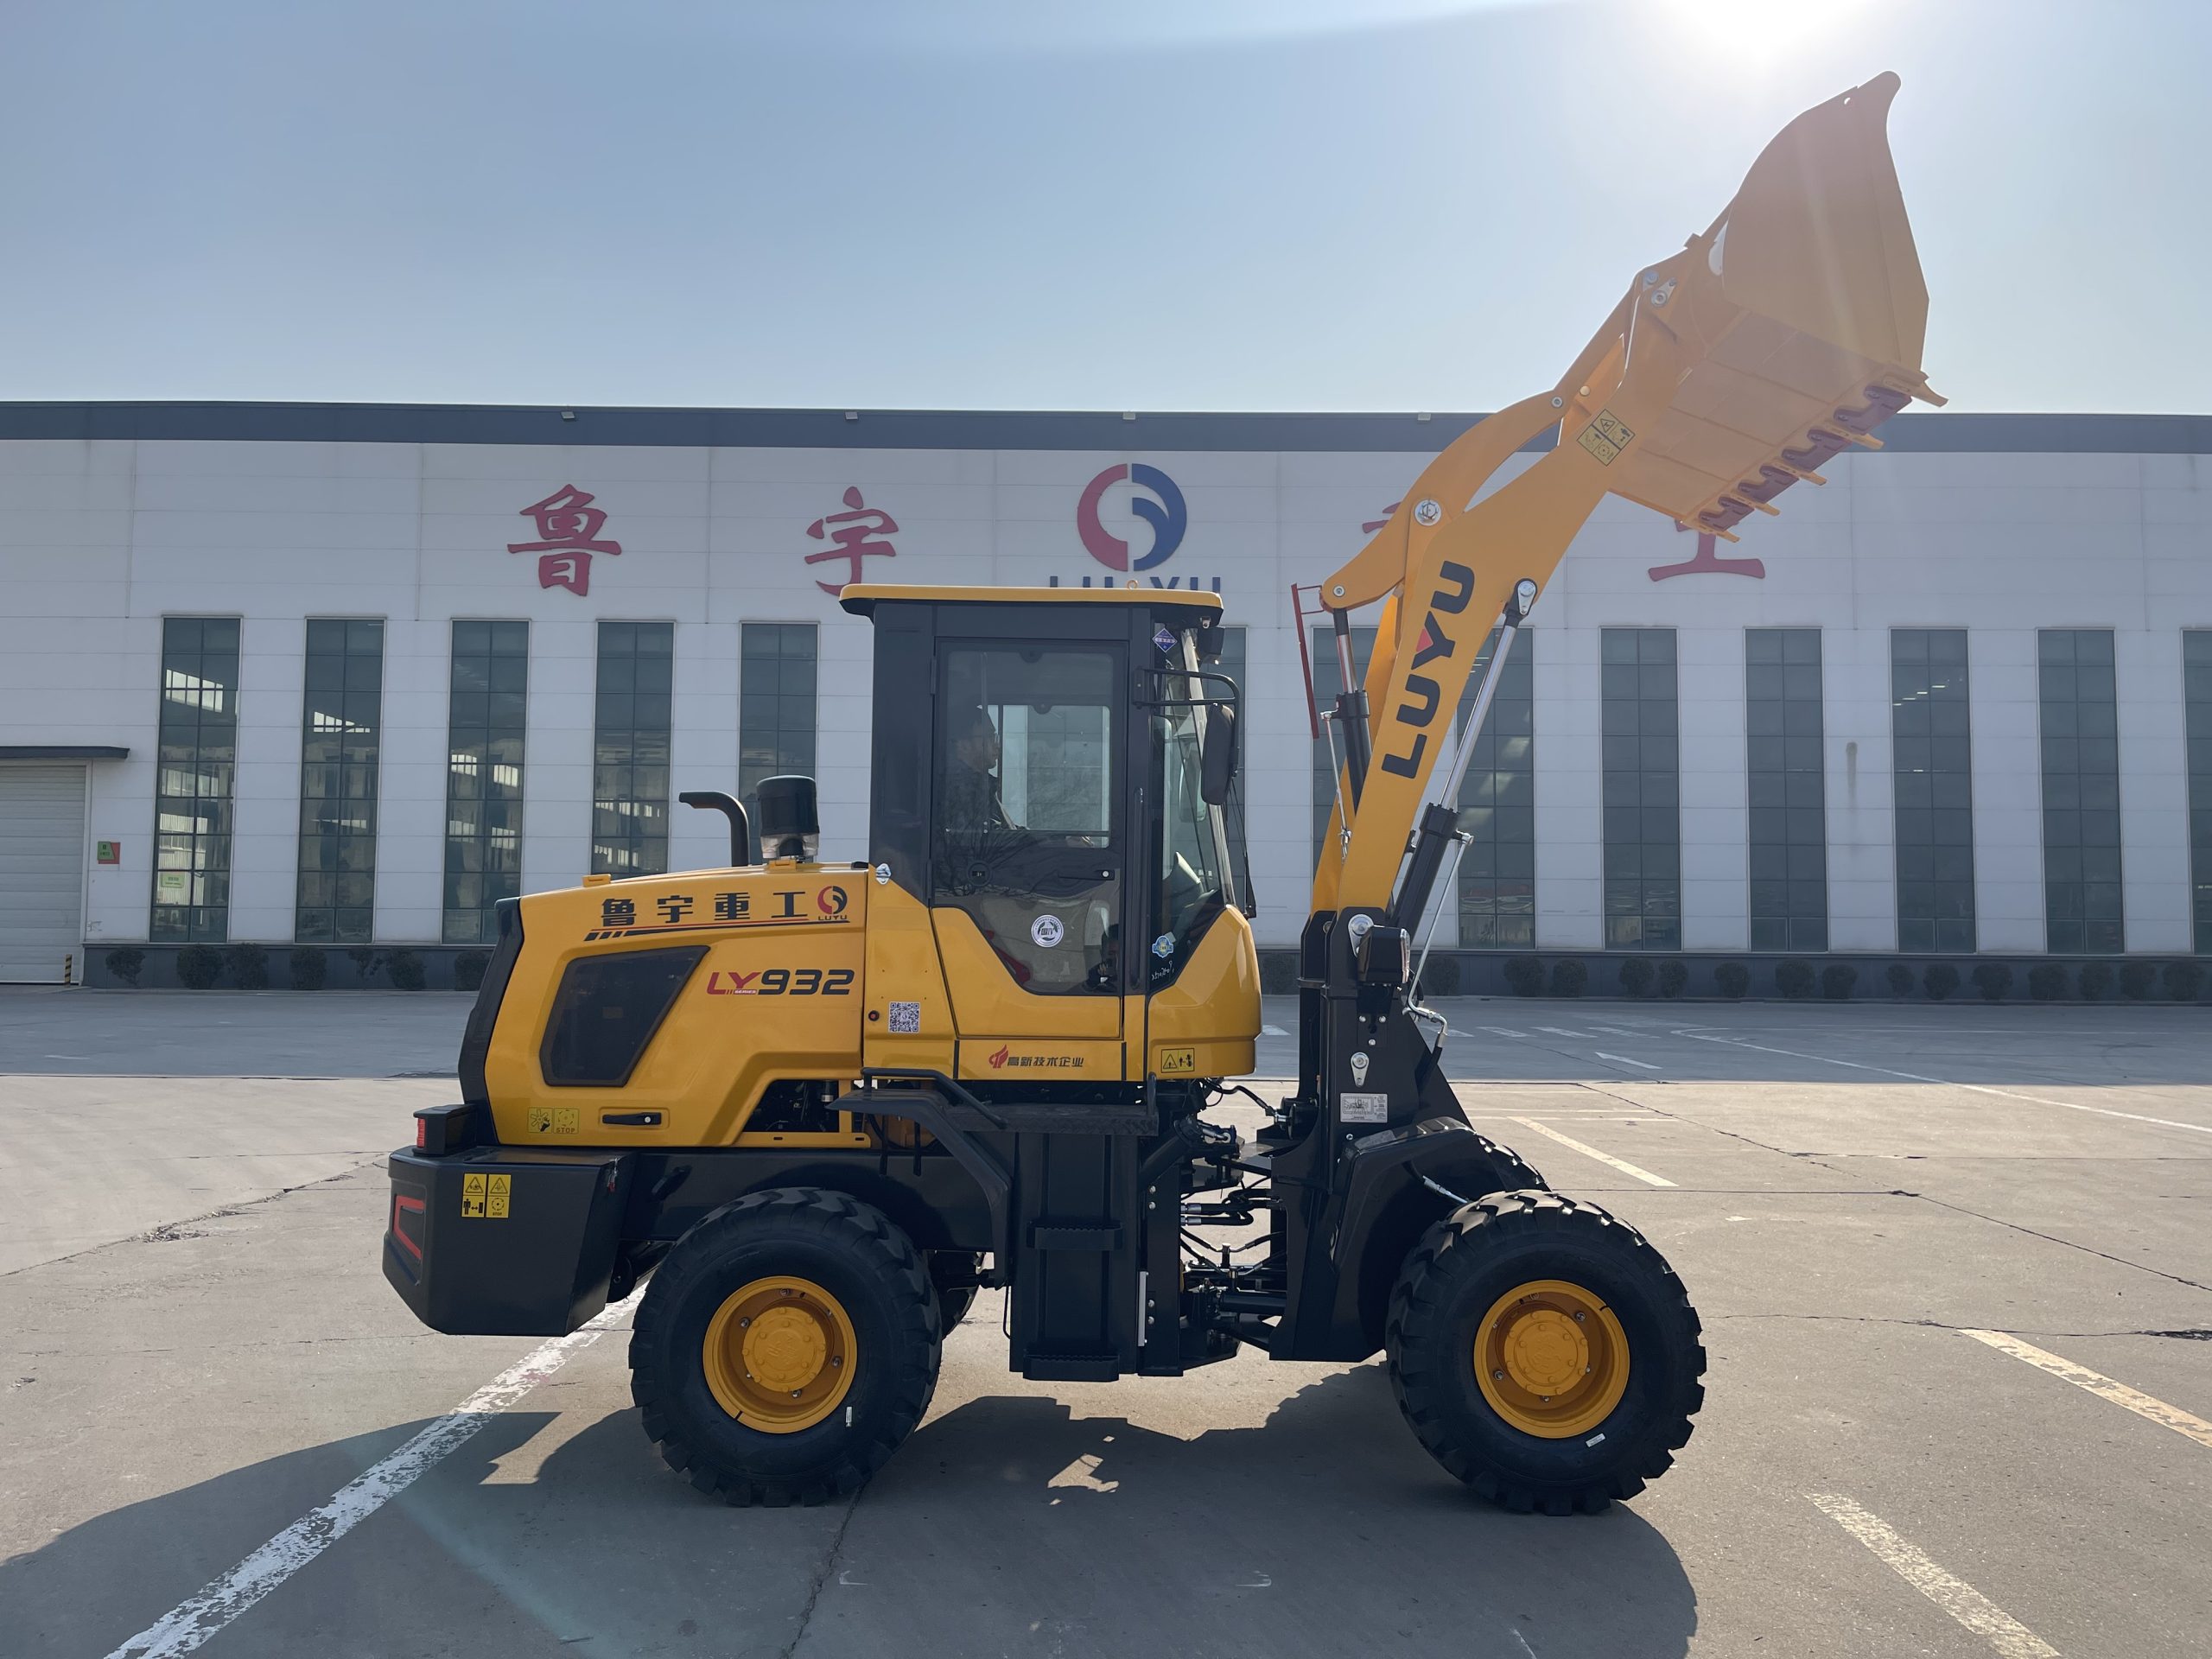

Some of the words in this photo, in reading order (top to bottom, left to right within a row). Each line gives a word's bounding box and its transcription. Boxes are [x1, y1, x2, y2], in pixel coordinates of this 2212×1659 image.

[1382, 560, 1476, 779] LUYU
[601, 892, 807, 926] 鲁宇重工
[706, 969, 855, 995] LY932
[1007, 1056, 1084, 1068] 高新技术企业
